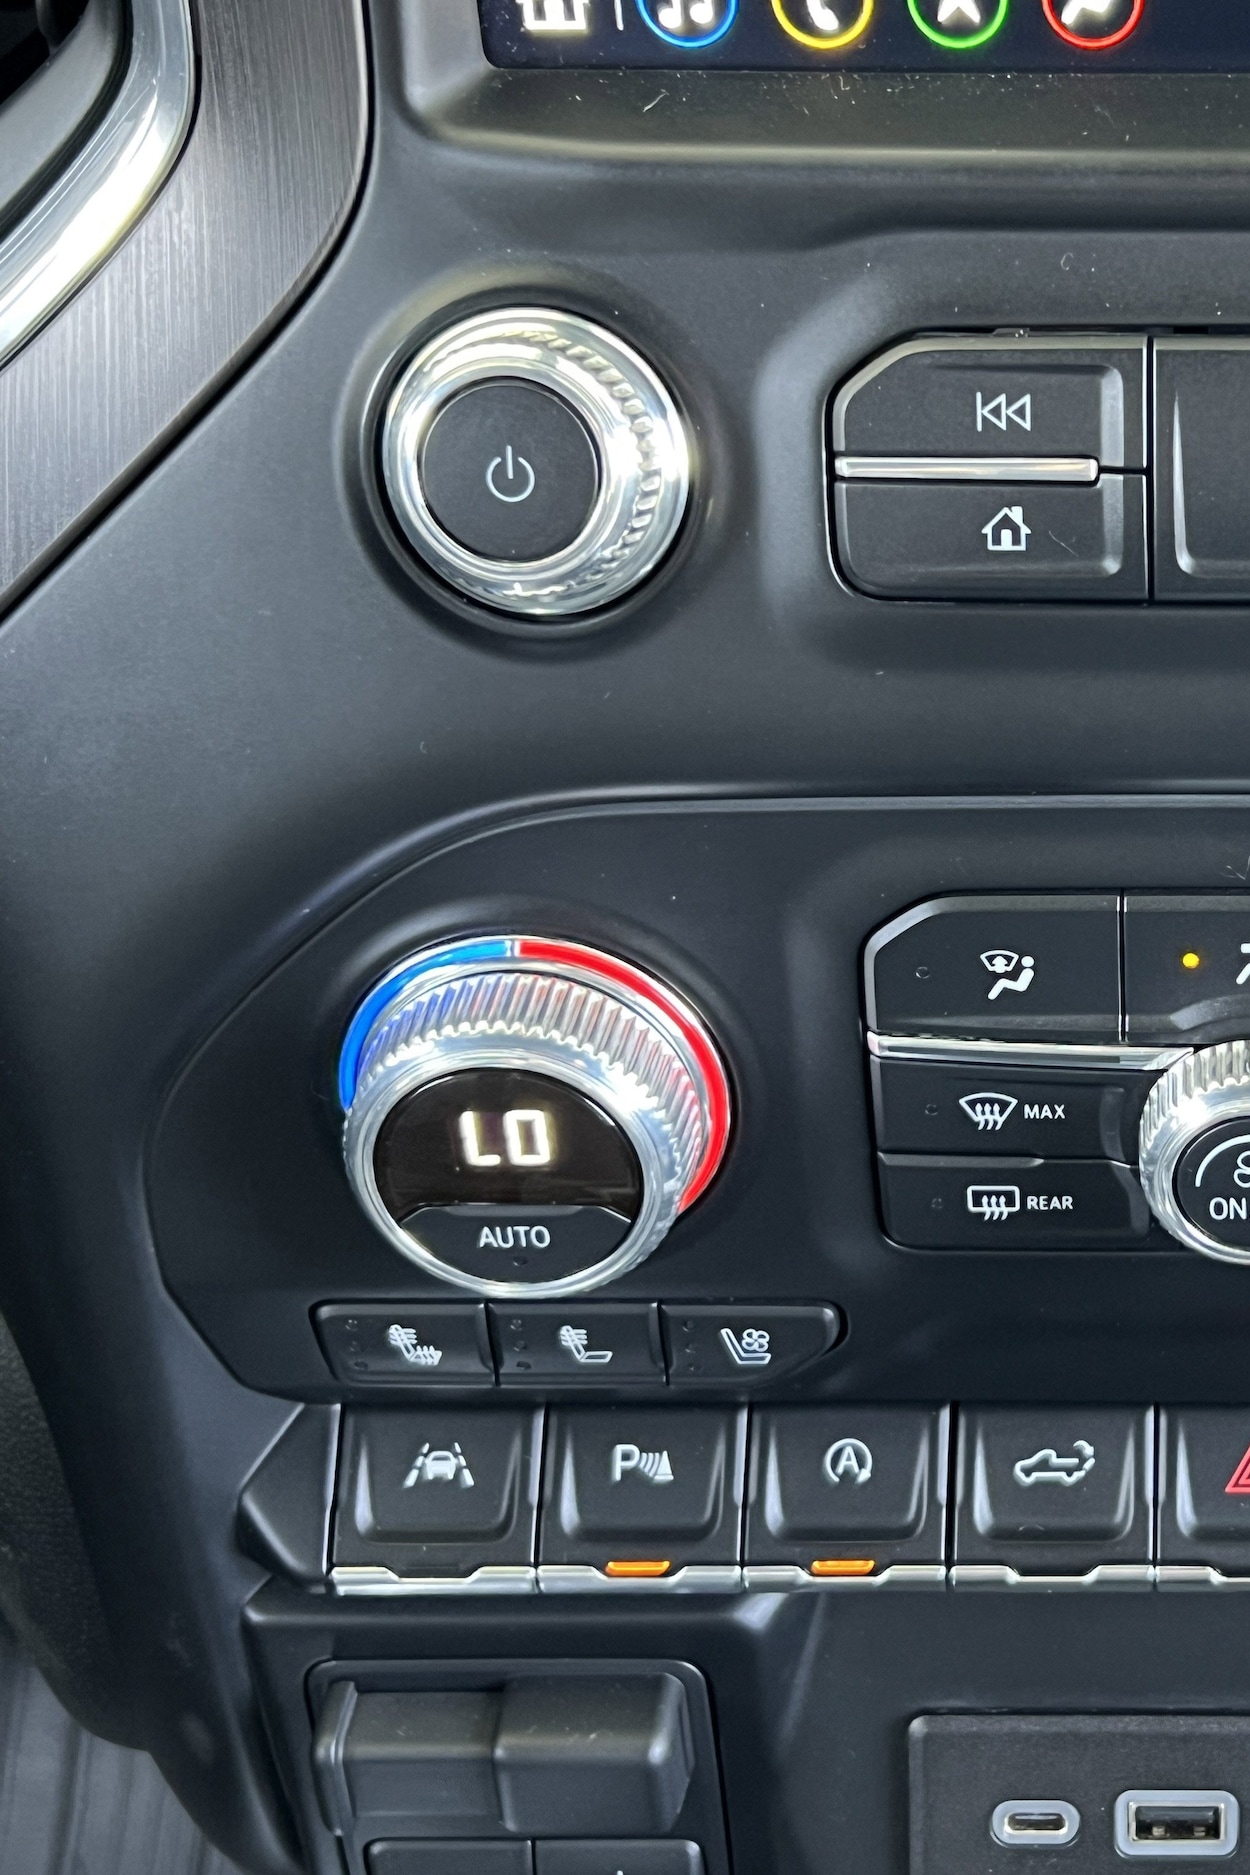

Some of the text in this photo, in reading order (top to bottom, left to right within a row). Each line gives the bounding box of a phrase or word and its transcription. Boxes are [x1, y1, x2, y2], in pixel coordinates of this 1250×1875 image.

[1023, 1103, 1066, 1120] MAX
[1026, 1195, 1074, 1211] REAR
[478, 1225, 551, 1249] AUTO
